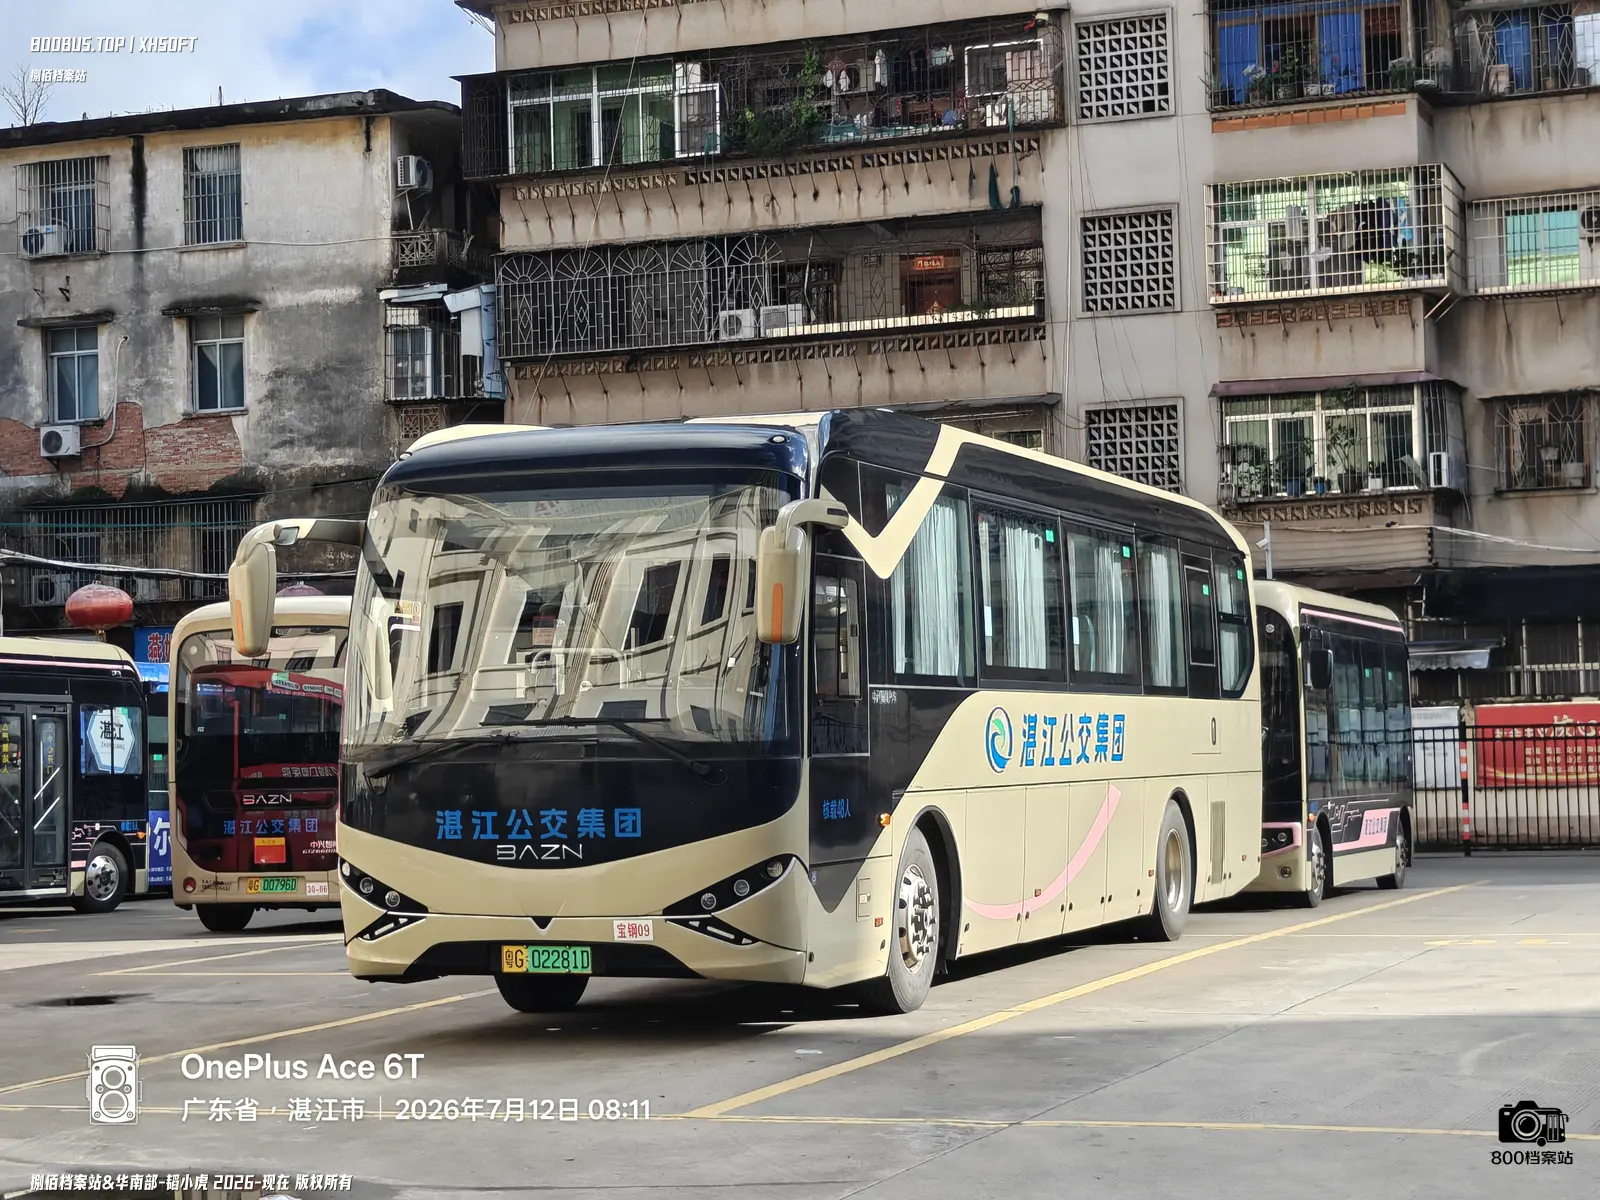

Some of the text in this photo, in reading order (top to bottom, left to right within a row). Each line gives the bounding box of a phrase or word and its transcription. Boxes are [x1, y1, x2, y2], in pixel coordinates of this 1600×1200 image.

[1019, 712, 1126, 768] 湛江公交集团
[243, 793, 292, 805] BAZN
[223, 817, 319, 835] 湛江公交集团
[436, 807, 642, 841] 湛江公交集团
[496, 843, 583, 861] BAZN
[307, 885, 328, 894] 30-06
[616, 922, 651, 940] 宝钢09
